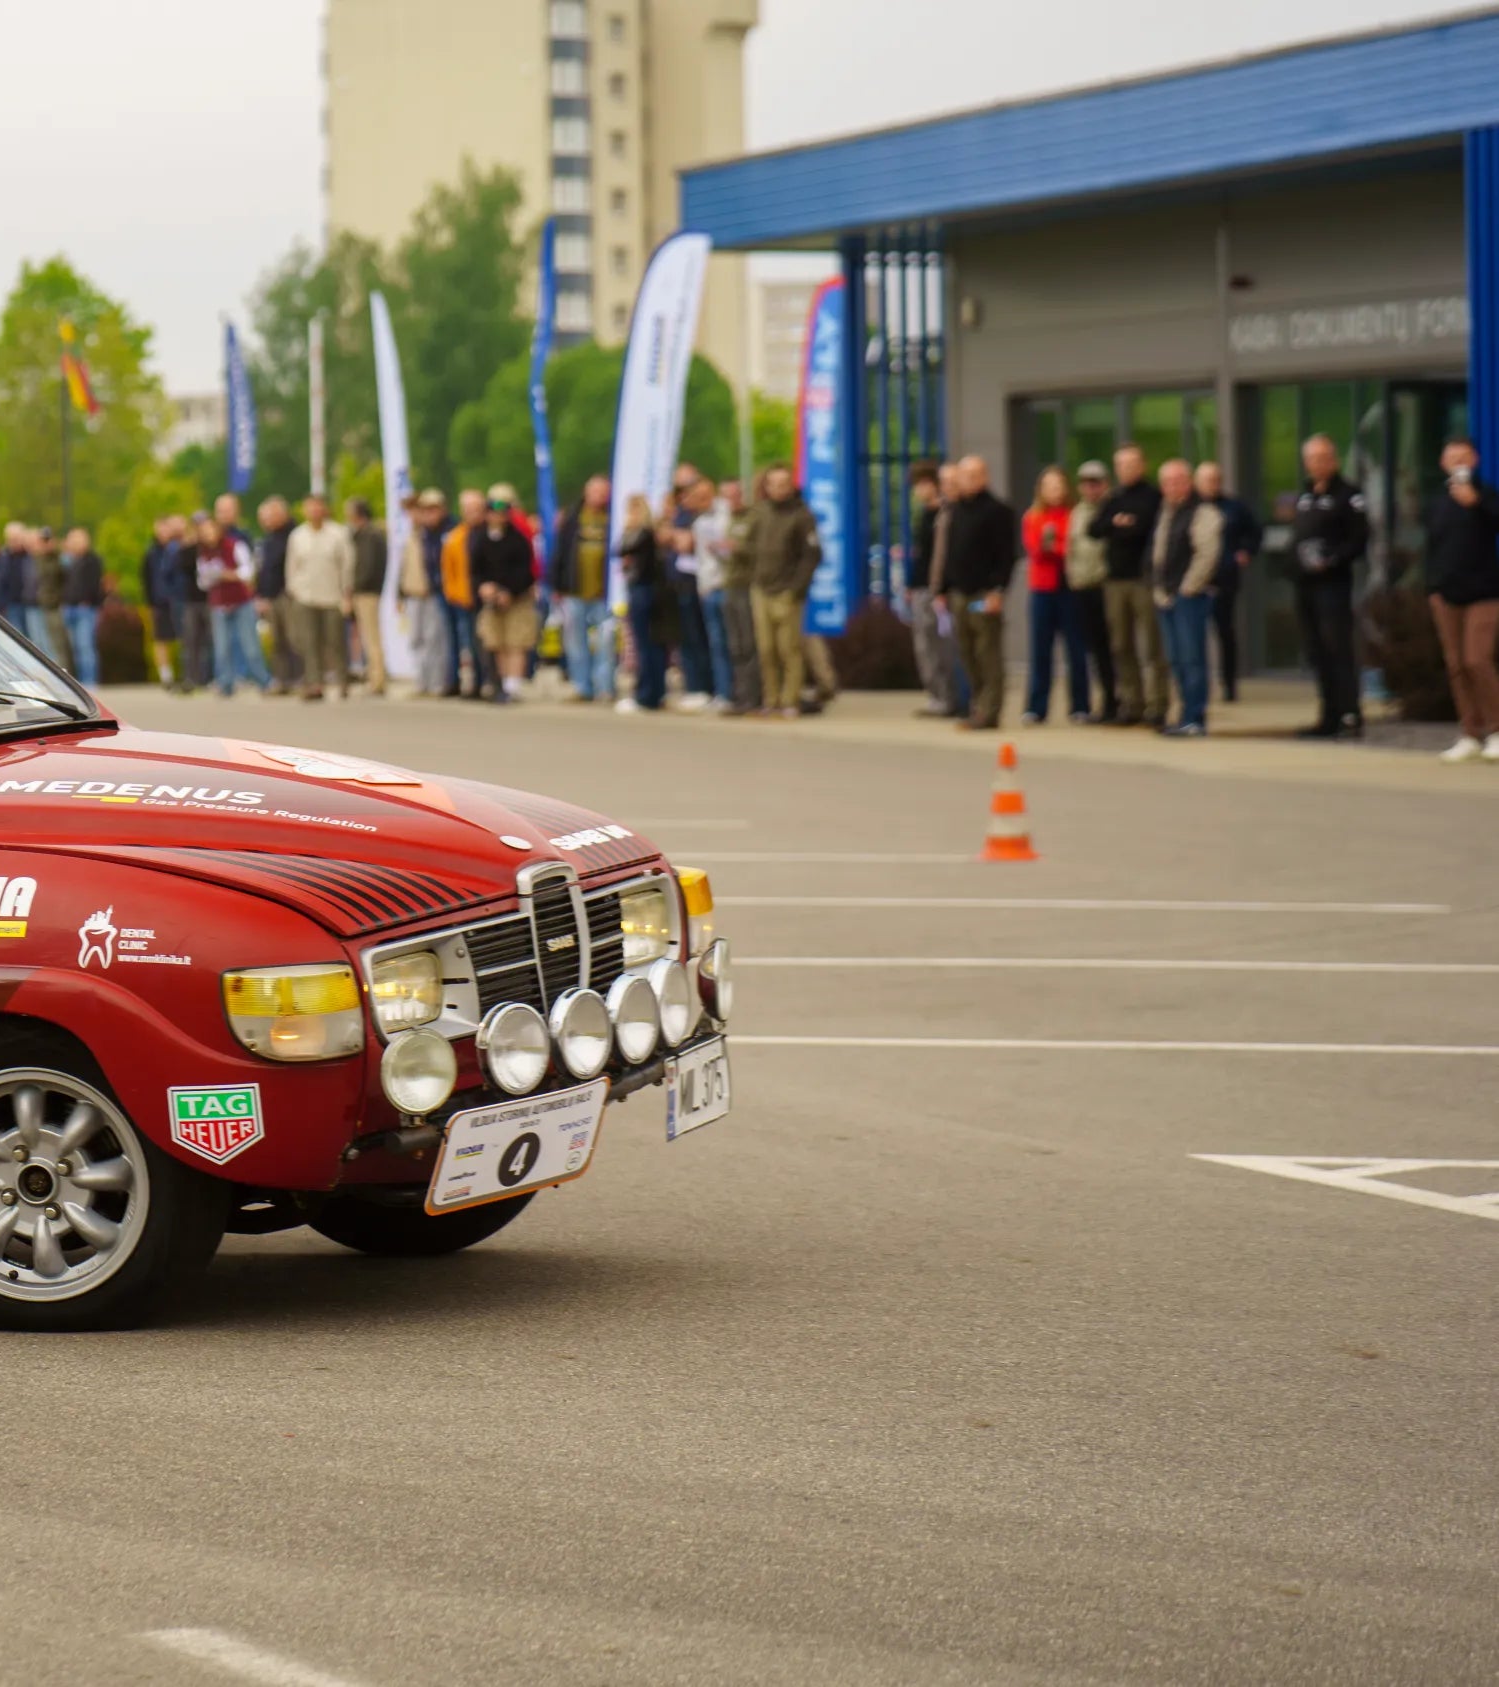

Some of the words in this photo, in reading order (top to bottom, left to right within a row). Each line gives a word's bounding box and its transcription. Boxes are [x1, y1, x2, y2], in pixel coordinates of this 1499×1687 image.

[141, 798, 178, 806] Gas
[183, 800, 269, 815] Pressure
[274, 810, 377, 832] Regulation
[118, 940, 148, 950] CLINIC
[120, 928, 156, 939] DENTAL
[180, 1094, 249, 1116] TAG
[180, 1120, 254, 1154] HEUER
[508, 1142, 529, 1176] 4
